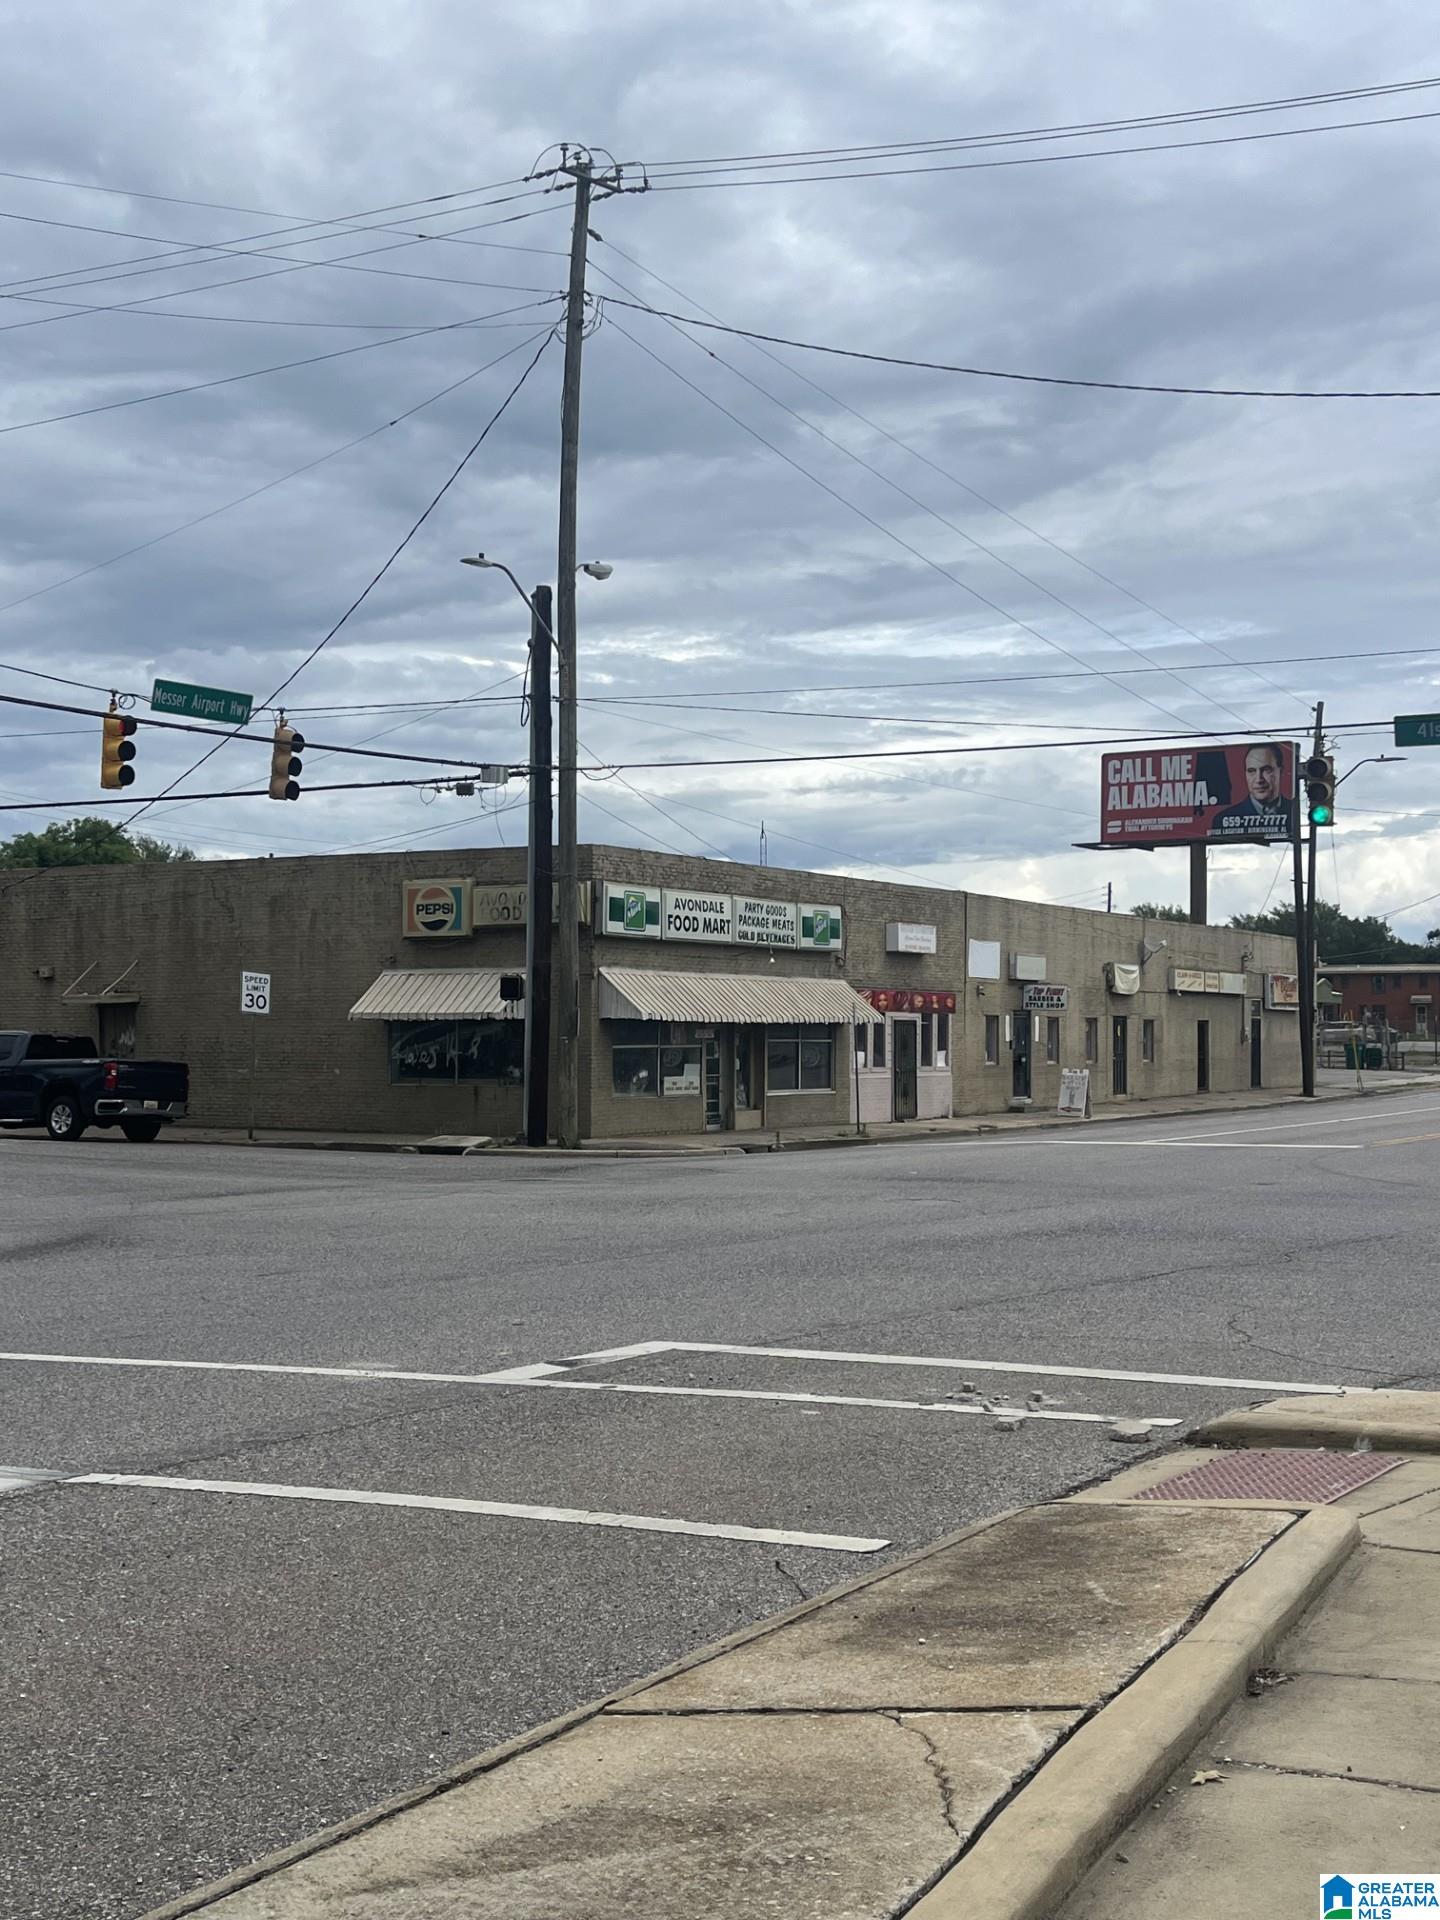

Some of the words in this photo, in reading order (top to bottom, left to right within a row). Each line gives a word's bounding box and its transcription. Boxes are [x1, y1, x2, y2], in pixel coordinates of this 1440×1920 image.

[154, 687, 187, 706] Messer
[192, 693, 225, 714] Airport
[231, 701, 250, 721] Hwy
[1107, 757, 1157, 784] CALL
[1161, 754, 1192, 781] ME
[1107, 780, 1218, 810] ALABAMA.
[1222, 814, 1288, 828] 659-777-7777
[416, 903, 454, 915] PEPSI
[674, 897, 724, 914] AVONDALE
[744, 901, 764, 915] PARTY
[765, 903, 787, 917] GOODS
[667, 914, 700, 933] FOOD
[702, 916, 731, 935] MART
[739, 914, 770, 929] PACKAGE
[772, 917, 794, 932] MEATS
[757, 931, 795, 945] BEVERAGES
[244, 975, 269, 985] SPEED
[246, 984, 266, 992] LIMIT
[244, 993, 267, 1010] 30
